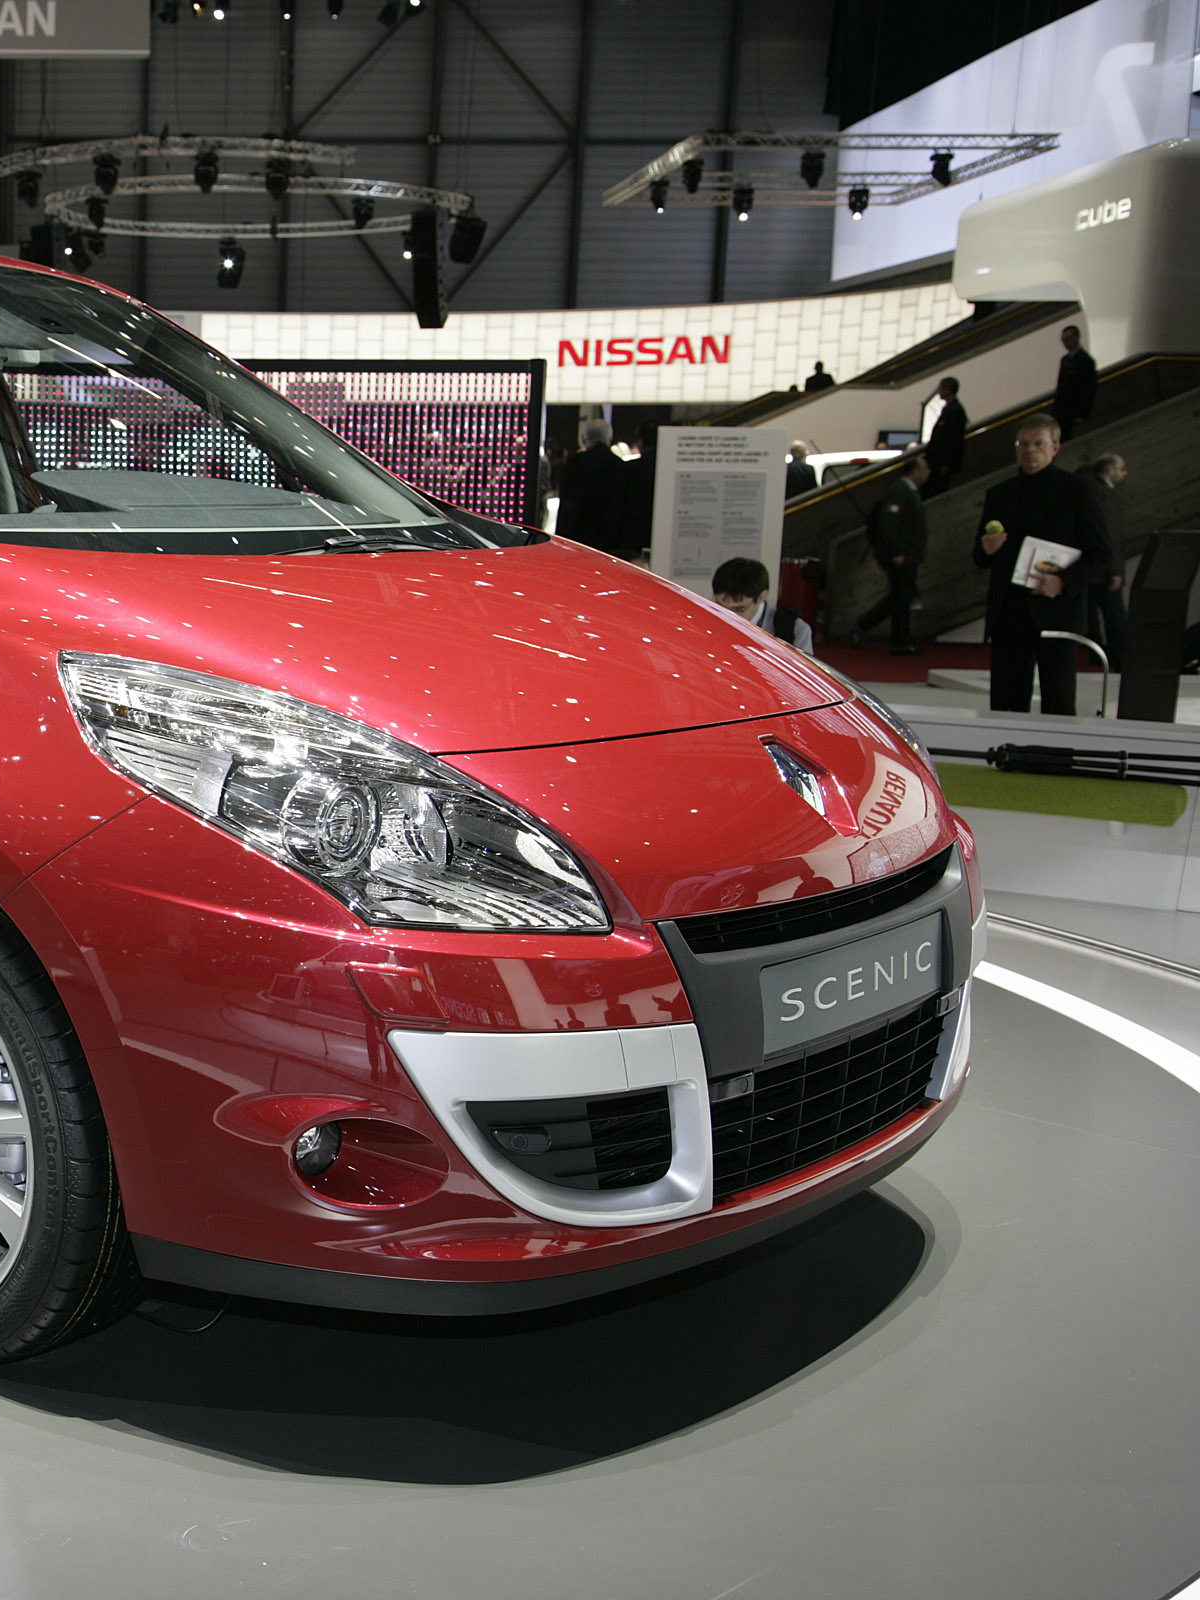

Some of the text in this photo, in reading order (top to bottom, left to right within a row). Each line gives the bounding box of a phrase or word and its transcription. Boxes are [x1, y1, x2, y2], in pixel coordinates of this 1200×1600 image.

[1074, 197, 1132, 231] cube
[558, 334, 731, 368] NISSAN
[780, 941, 932, 1022] SCENIC
